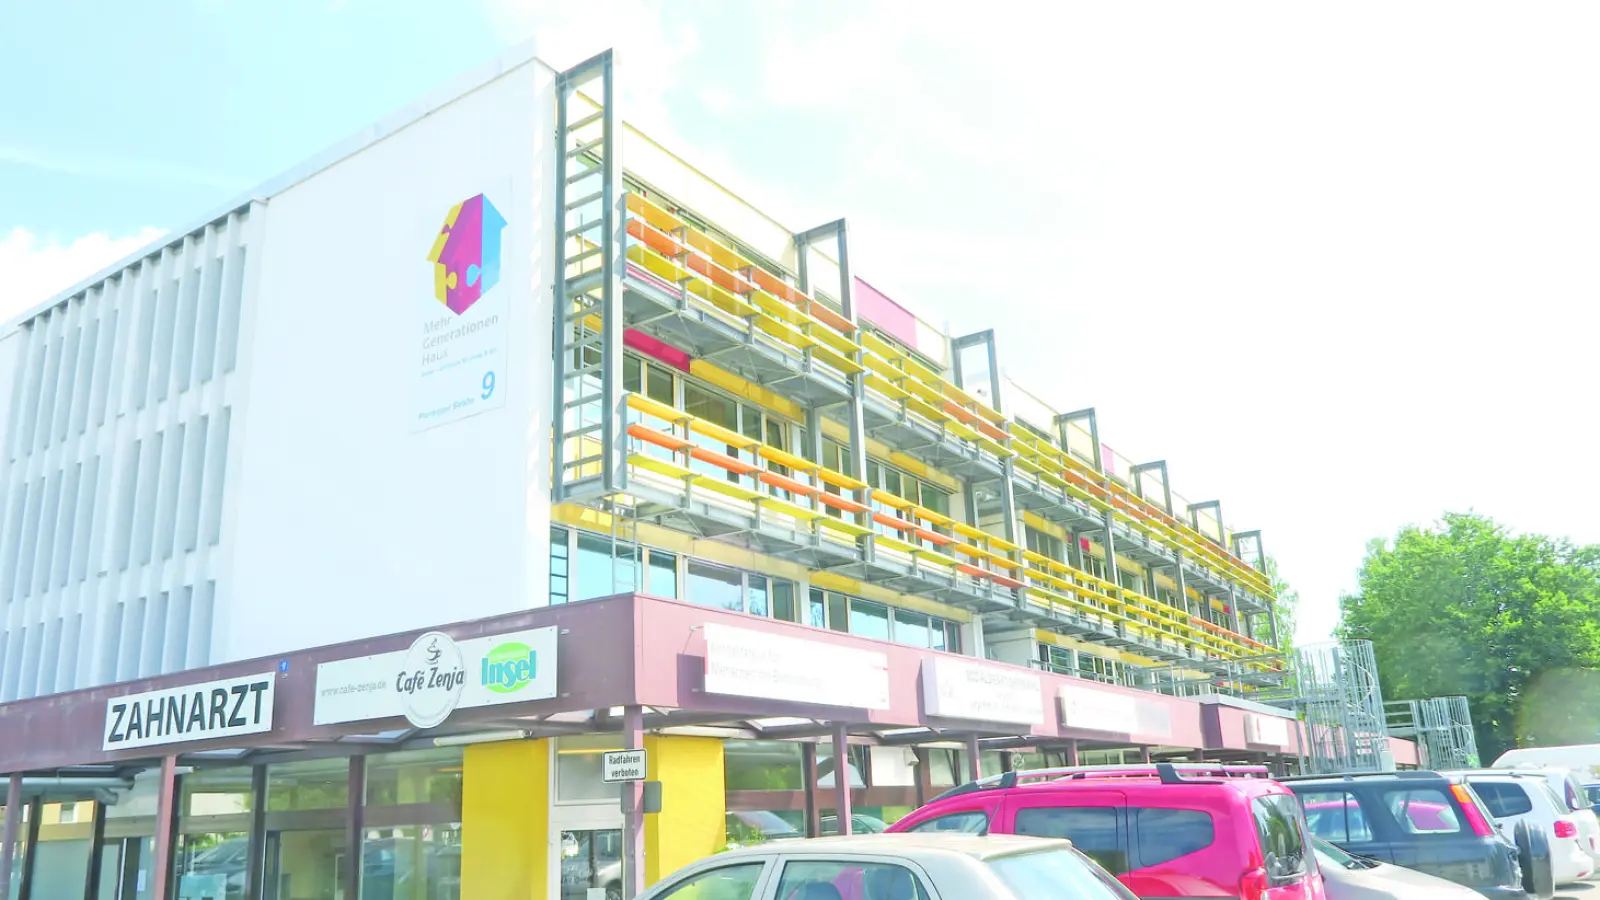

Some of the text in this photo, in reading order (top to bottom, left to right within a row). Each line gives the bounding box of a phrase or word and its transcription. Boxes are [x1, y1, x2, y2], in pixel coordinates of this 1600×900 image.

[423, 315, 498, 349] Generationen
[424, 316, 452, 334] Mehr
[422, 349, 448, 365] Haus
[481, 371, 495, 400] 9
[396, 667, 465, 694] Café Zenja
[481, 650, 537, 688] Insel
[108, 682, 269, 742] ZAHNARZT
[608, 755, 641, 765] Radfahren
[611, 768, 639, 778] verboten
